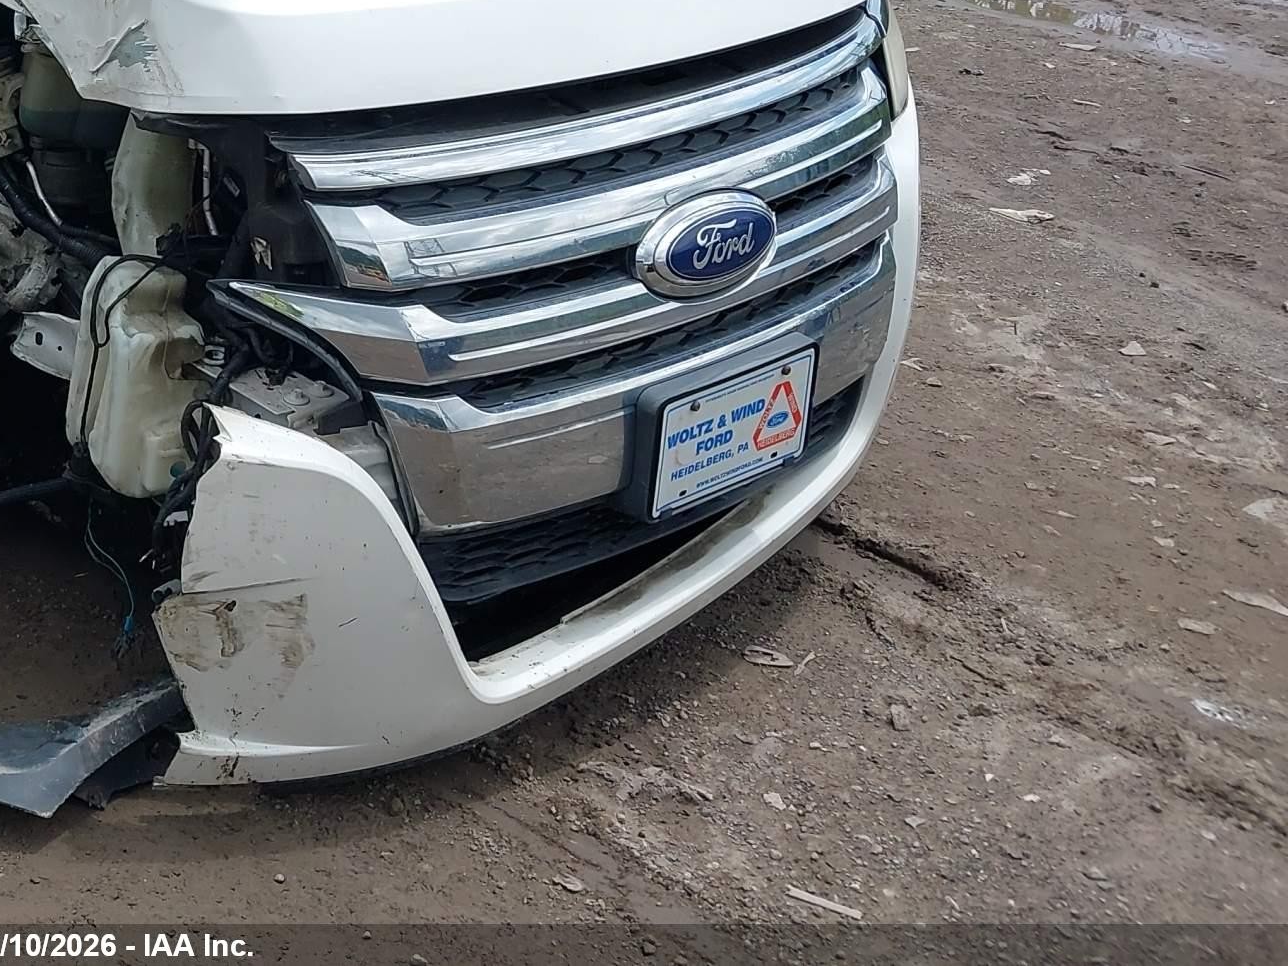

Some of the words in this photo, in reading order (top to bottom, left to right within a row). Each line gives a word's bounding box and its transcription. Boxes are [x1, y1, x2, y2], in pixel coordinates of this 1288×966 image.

[692, 218, 755, 270] Ford
[667, 419, 715, 450] WOLTZ
[717, 414, 728, 429] &
[731, 398, 766, 424] WIND
[695, 429, 734, 456] FORD
[670, 448, 734, 482] HEIDELBERG,
[737, 442, 749, 455] PA
